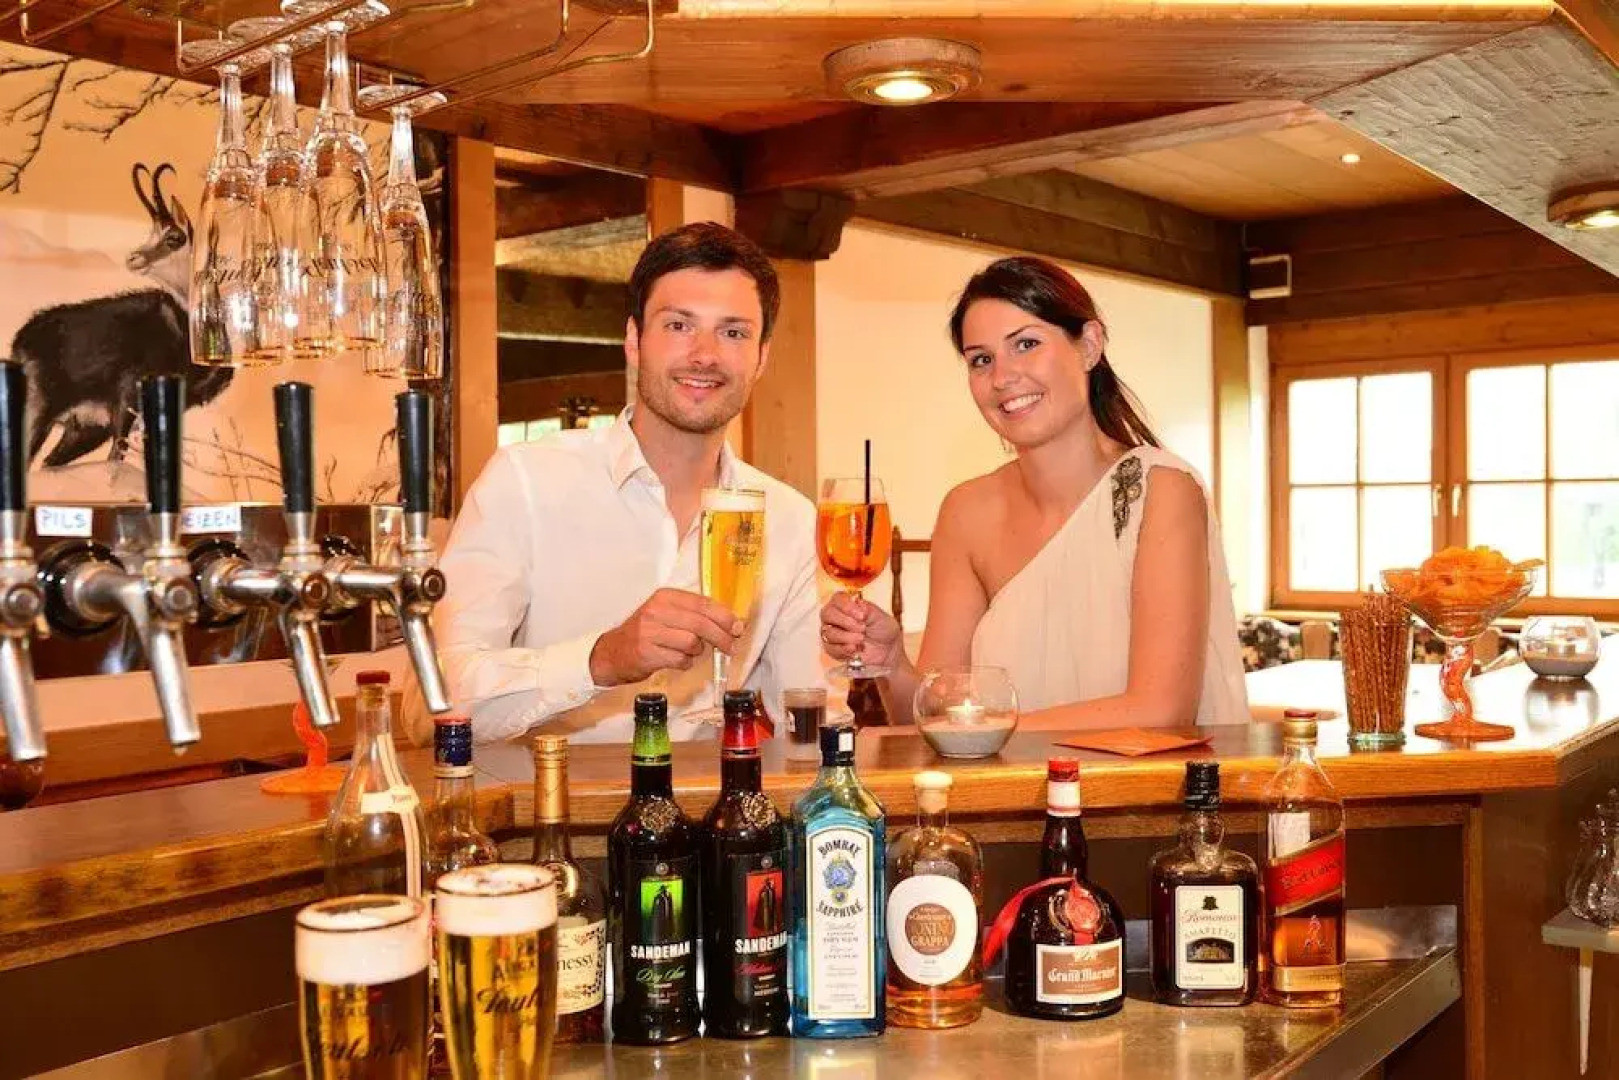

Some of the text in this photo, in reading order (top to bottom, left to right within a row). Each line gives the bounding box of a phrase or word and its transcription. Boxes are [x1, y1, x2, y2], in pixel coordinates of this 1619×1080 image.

[41, 510, 87, 528] PILS
[818, 840, 861, 858] BOMBAY
[816, 899, 864, 917] SAPPHIRE
[631, 941, 690, 960] SANDEMAN
[735, 931, 788, 954] SANDEMAN
[911, 936, 949, 947] GRAPPA
[556, 953, 596, 971] nessy
[1047, 967, 1081, 984] Grand
